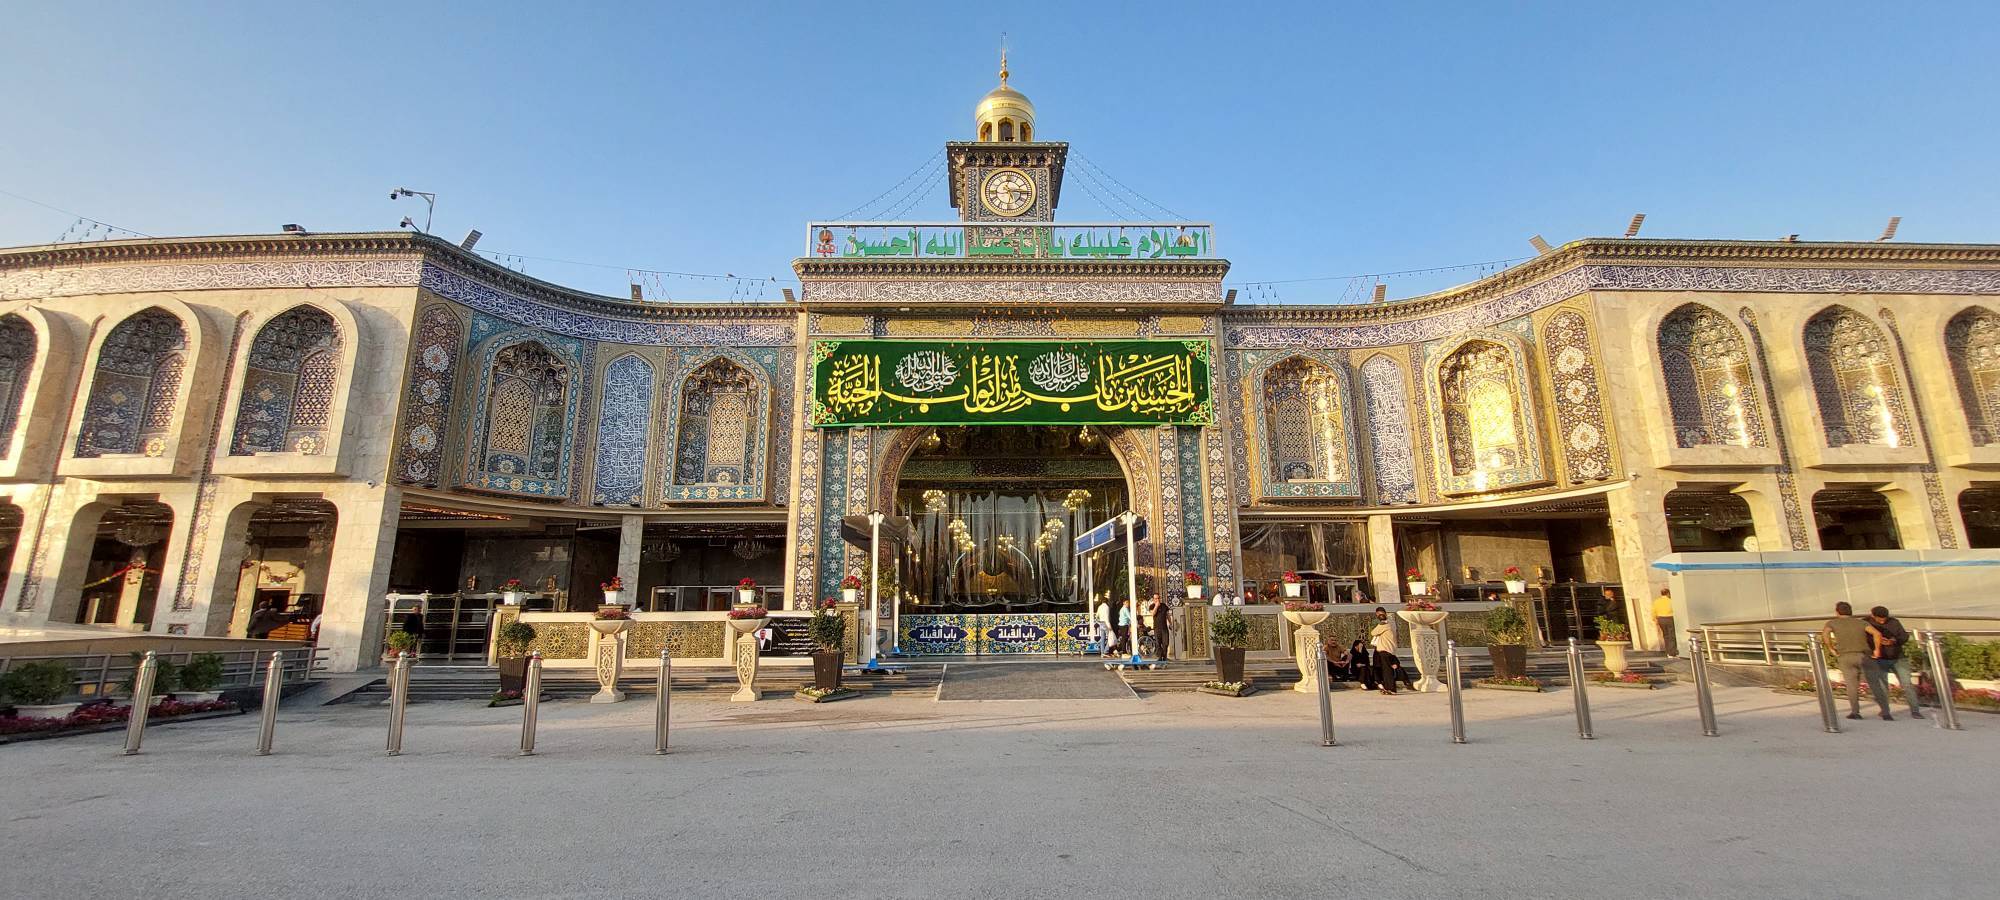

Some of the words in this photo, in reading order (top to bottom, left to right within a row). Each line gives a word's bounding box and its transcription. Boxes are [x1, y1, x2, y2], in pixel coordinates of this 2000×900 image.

[843, 228, 922, 258] الحسين
[925, 230, 964, 256] الله
[1069, 228, 1132, 258] عليك
[1137, 228, 1208, 258] السلام
[919, 628, 942, 641] القبلة
[943, 628, 957, 641] باب
[998, 627, 1022, 641] القبلة
[1022, 627, 1036, 640] باب
